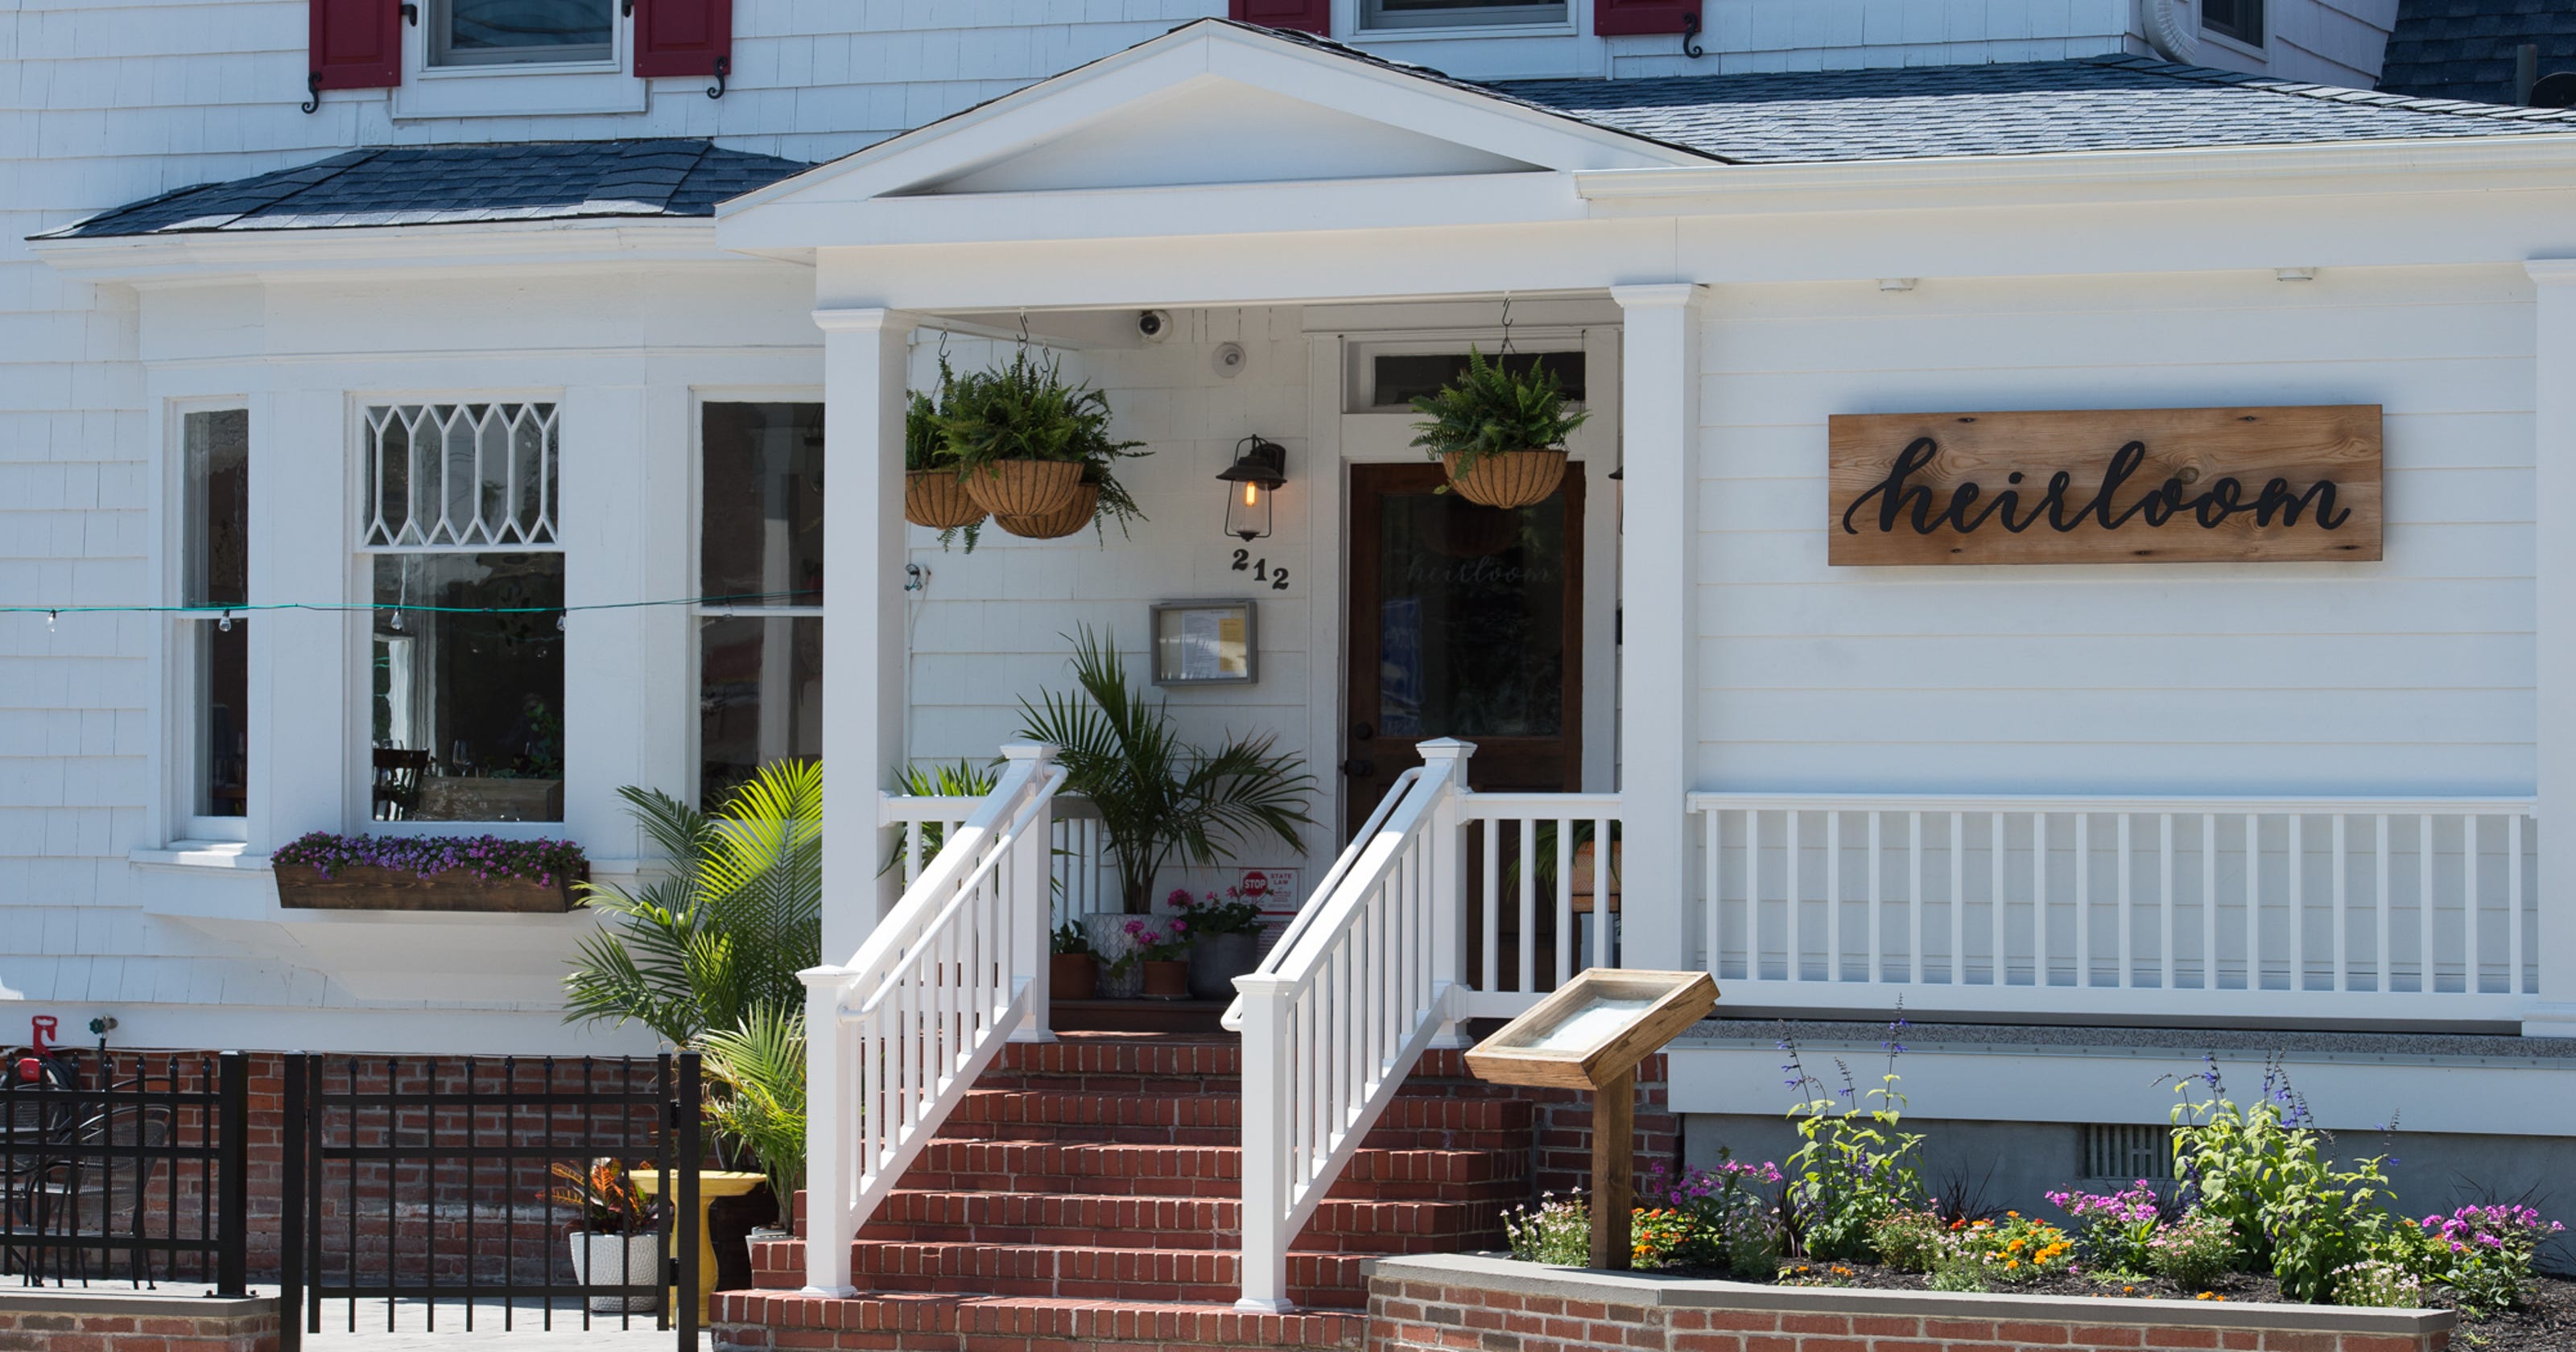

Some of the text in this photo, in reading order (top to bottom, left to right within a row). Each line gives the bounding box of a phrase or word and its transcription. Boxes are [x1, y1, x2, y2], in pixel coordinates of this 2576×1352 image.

[1843, 436, 2351, 534] heirloom
[1232, 549, 1290, 590] 212
[1408, 553, 1549, 583] heirloom
[1245, 879, 1266, 889] STOP
